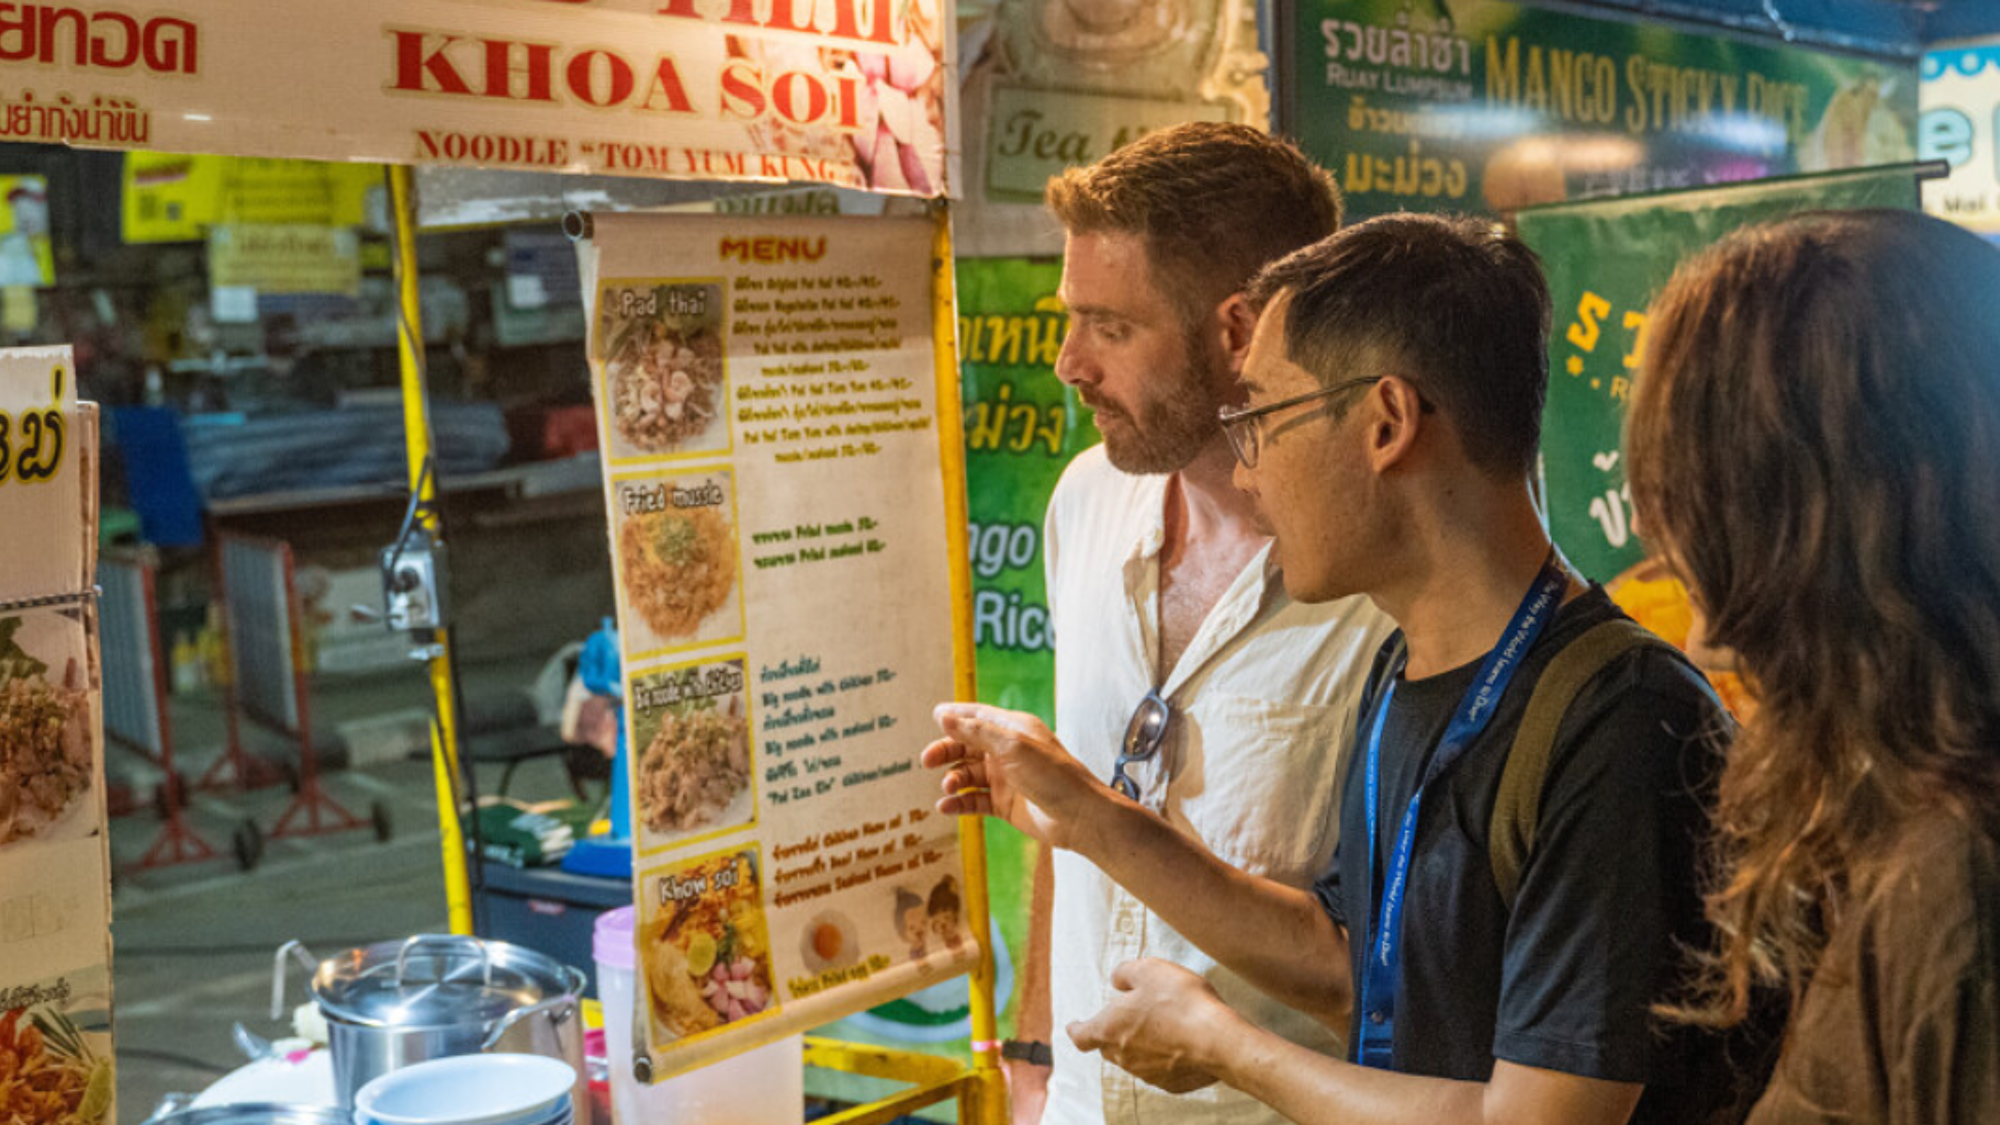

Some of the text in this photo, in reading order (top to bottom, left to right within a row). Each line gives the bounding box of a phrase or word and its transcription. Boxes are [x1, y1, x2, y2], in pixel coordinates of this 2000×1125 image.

[388, 30, 700, 113] KHOA
[1486, 35, 1617, 124] MANGO
[416, 130, 568, 166] NOODLE
[684, 147, 745, 176] YUM
[999, 108, 1093, 163] Tea
[1345, 139, 1467, 199] มะม่วง
[720, 235, 827, 264] MENU
[622, 290, 658, 316] Pad
[669, 289, 707, 314] thai
[623, 483, 665, 515] Fried
[659, 874, 707, 905] Khow
[714, 858, 738, 890] soi
